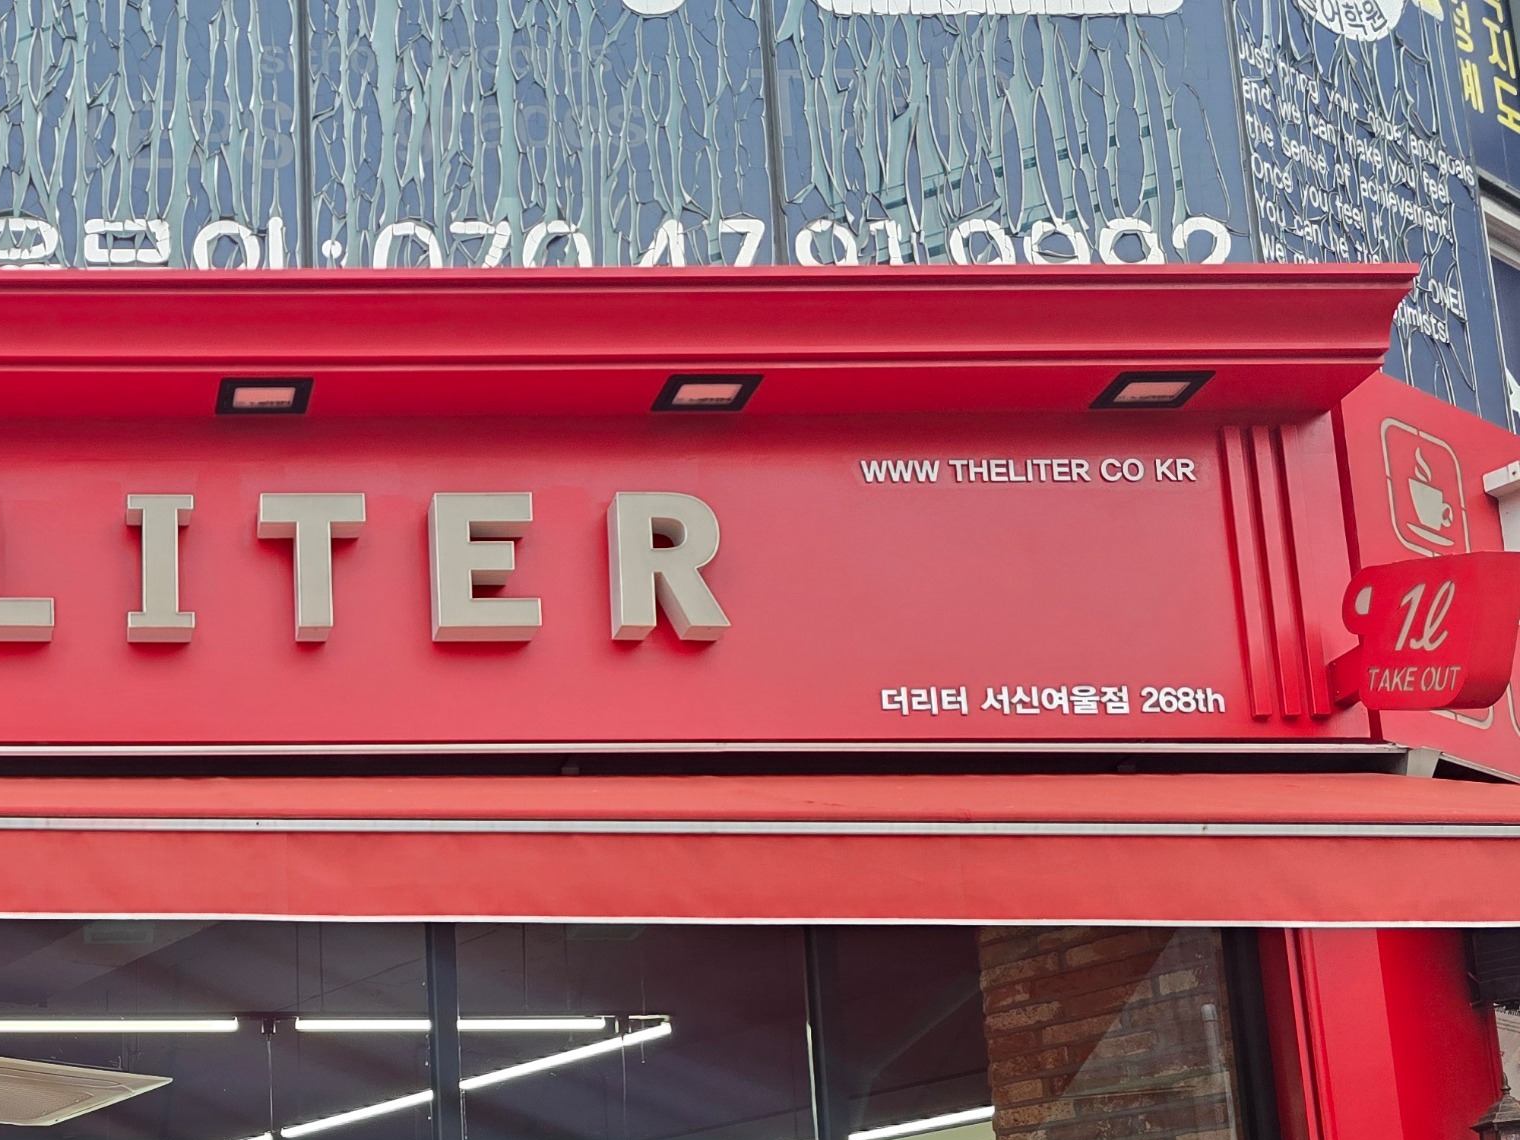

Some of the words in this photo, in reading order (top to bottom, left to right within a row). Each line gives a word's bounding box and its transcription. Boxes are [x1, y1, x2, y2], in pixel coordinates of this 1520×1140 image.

[860, 459, 940, 483] WWW
[948, 458, 1091, 482] THELITER
[1099, 457, 1145, 481] CO
[1155, 458, 1197, 482] KR
[1367, 665, 1417, 694] TAKE
[1420, 665, 1462, 693] OUT
[880, 686, 968, 716] 더리터
[980, 685, 1131, 716] 서신여울점
[1140, 686, 1226, 714] 268th
